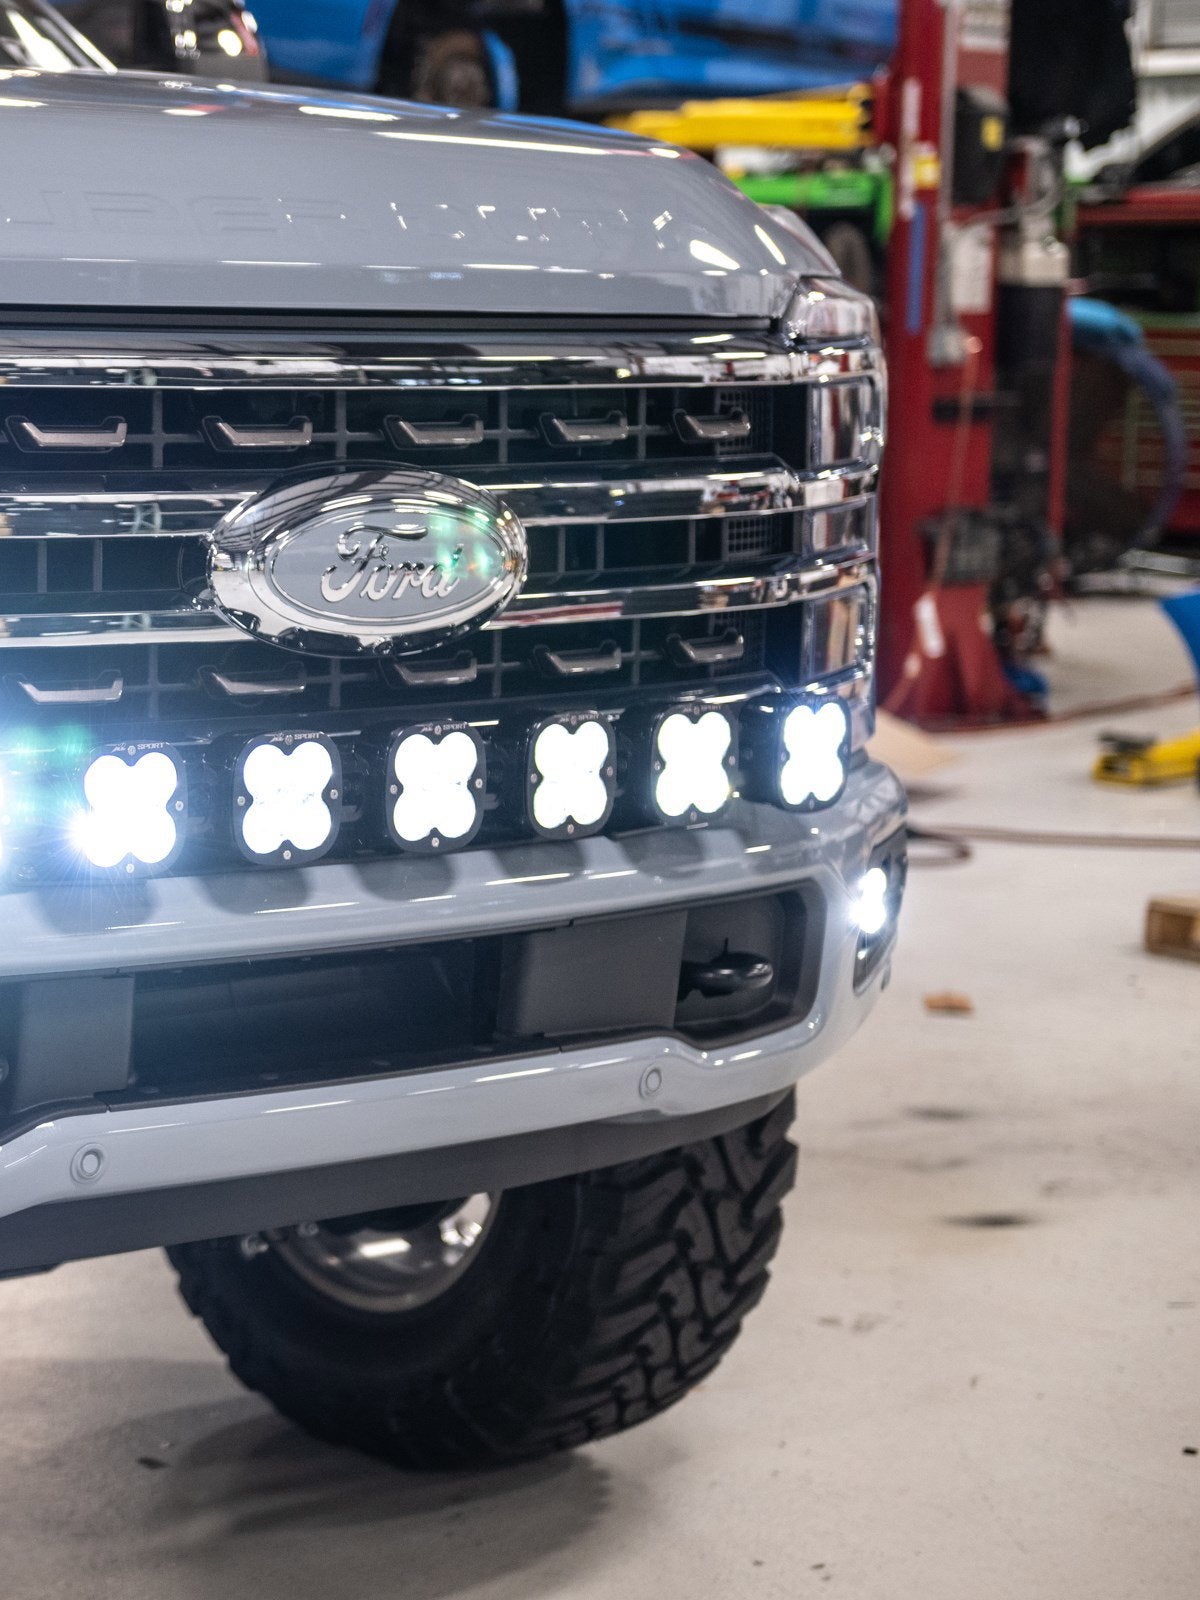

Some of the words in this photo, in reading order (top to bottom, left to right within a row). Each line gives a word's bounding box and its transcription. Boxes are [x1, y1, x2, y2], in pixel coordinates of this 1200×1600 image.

[319, 524, 463, 603] Ford
[294, 732, 320, 740] SPORT
[137, 742, 164, 750] SPORT
